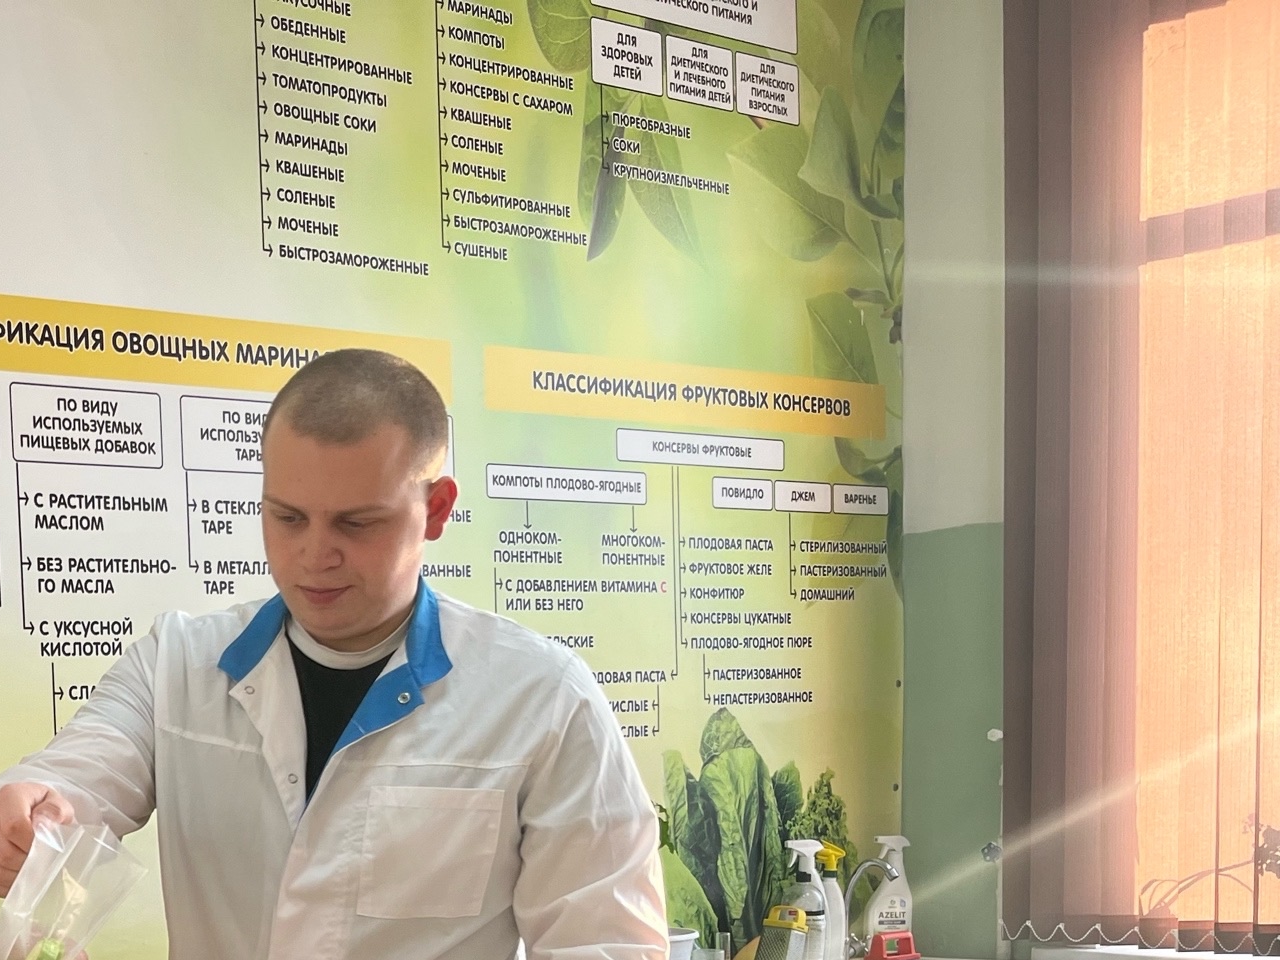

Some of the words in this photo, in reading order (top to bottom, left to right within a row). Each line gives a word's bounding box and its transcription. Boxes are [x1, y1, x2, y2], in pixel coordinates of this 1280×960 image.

[448, 0, 513, 25] МАРИНАДЫ
[711, 6, 753, 25] ПИТАНИЯ
[271, 16, 346, 43] ОБЕДЕННЫЕ
[449, 26, 505, 50] КОМПОТЫ
[617, 33, 637, 47] ДЛЯ
[601, 46, 653, 67] ЗДОРОВЫХ
[691, 47, 708, 59] ДЛЯ
[271, 45, 413, 85] КОНЦЕНТРИРОВАННЫЕ
[449, 53, 574, 90] КОНЦЕНТРИРОВАННЫЕ
[613, 65, 642, 81] ДЕТЕЙ
[671, 56, 729, 77] ДИЕТИЧЕСКОГО
[760, 63, 776, 75] ДЛЯ
[674, 69, 681, 79] И
[683, 72, 726, 90] ЛЕЧЕБНОГО
[740, 72, 795, 92] ДИЕТИЧЕСКОГО
[272, 73, 387, 107] ТОМАТОПРОДУКТЫ
[450, 80, 509, 103] КОНСЕРВЫ
[513, 93, 520, 105] С
[523, 95, 573, 115] САХАРОМ
[670, 82, 706, 99] ПИТАНИЯ
[708, 91, 731, 104] ДЕТЕЙ
[751, 88, 786, 103] ПИТАНИЯ
[749, 100, 788, 116] ВЗРОСЛЫХ
[274, 103, 340, 126] ОВОЩНЫЕ
[344, 115, 377, 133] СОКИ
[451, 108, 512, 130] КВАШЕНЫЕ
[613, 113, 691, 138] ПЮРЕОБРАЗНЫЕ
[275, 131, 348, 156] МАРИНАДЫ
[452, 135, 504, 155] СОЛЕНЫЕ
[614, 139, 640, 153] СОКИ
[276, 160, 345, 183] КВАШЕНЫЕ
[452, 162, 507, 182] МОЧЕНЫЕ
[614, 164, 730, 194] КРУПНОИЗМЕЛЬЧЕННЫЕ
[277, 188, 336, 209] СОЛЕНЫЕ
[453, 189, 571, 217] СУЛЬФИТИРОВАННЫЕ
[278, 217, 339, 237] МОЧЕНЫЕ
[454, 216, 587, 246] БЫСТРОЗАМОРОЖЕННЫЕ
[455, 242, 508, 260] СУШЕНЫЕ
[279, 245, 429, 276] БЫСТРОЗАМОРОЖЕННЫЕ
[112, 330, 230, 364] ОВОЩНЫХ
[236, 343, 321, 370] МАРИНА
[532, 370, 677, 402] КЛАССИФИКАЦИЯ
[682, 384, 769, 411] ФРУКТОВЫХ
[773, 392, 851, 417] КОНСЕРВОВ
[57, 398, 77, 413] ПО
[82, 400, 118, 417] ВИДУ
[32, 415, 143, 436] ИСПОЛЬЗУЕМЫХ
[222, 410, 241, 424] ПО
[19, 434, 91, 452] ПИЩЕВЫХ
[94, 439, 156, 455] ДОБАВОК
[652, 440, 699, 455] КОНСЕРВЫ
[702, 443, 752, 458] ФРУКТОВЫЕ
[492, 473, 543, 489] КОМПОТЫ
[546, 477, 641, 494] ПЛОДОВО-ЯГОДНЫЕ
[721, 486, 764, 500] ПОВИДЛО
[791, 491, 816, 503] ДЖЕМ
[844, 493, 877, 505] ВАРЕНЬЕ
[34, 492, 44, 508] С
[49, 493, 168, 513] РАСТИТЕЛЬНЫМ
[201, 500, 210, 514] В
[34, 514, 104, 531] МАСЛОМ
[202, 520, 232, 534] ТАРЕ
[499, 530, 562, 545] ОДНОКОМ-
[601, 534, 665, 548] МНОГОКОМ-
[688, 537, 742, 551] ПЛОДОВАЯ
[745, 539, 774, 551] ПАСТА
[800, 540, 887, 555] СТЕРИЛИЗОВАННЫЙ
[37, 557, 63, 573] БЕЗ
[68, 558, 177, 574] РАСТИТЕЛЬНО-
[494, 550, 562, 564] ПОНЕНТНЫЕ
[602, 553, 665, 566] ПОНЕНТНЫЕ
[204, 561, 212, 574] В
[217, 561, 270, 575] МЕТАЛЛ
[422, 564, 471, 577] ВАННЫЕ
[689, 562, 744, 576] ФРУКТОВОЕ
[747, 563, 772, 575] ЖЕЛЕ
[800, 564, 887, 578] ПАСТЕРИЗОВАННЫЙ
[38, 578, 56, 594] ГО
[61, 578, 114, 594] МАСЛА
[204, 581, 234, 594] ТАРЕ
[506, 579, 512, 592] С
[516, 579, 597, 593] ДОБАВЛЕНИЕМ
[601, 581, 657, 593] ВИТАМИНА
[660, 582, 667, 593] С
[689, 587, 744, 600] КОНФИТЮР
[800, 586, 855, 602] ДОМАШНИЙ
[506, 598, 531, 611] ИЛИ
[535, 599, 553, 611] БЕЗ
[558, 599, 584, 611] НЕГО
[39, 620, 49, 636] С
[53, 616, 133, 639] УКСУСНОЙ
[690, 613, 741, 625] КОНСЕРВЫ
[744, 612, 792, 626] ЦУКАТНЫЕ
[40, 637, 123, 657] КИСЛОТОЙ
[690, 636, 784, 650] ПЛОДОВО-ЯГОДНОЕ
[787, 636, 812, 648] ПЮРЕ
[635, 670, 667, 683] ПАСТА
[712, 667, 801, 681] ПАСТЕРИЗОВАННОЕ
[713, 691, 813, 706] НЕПАСТЕРИЗОВАННОЕ
[879, 911, 906, 919] AZELIT
